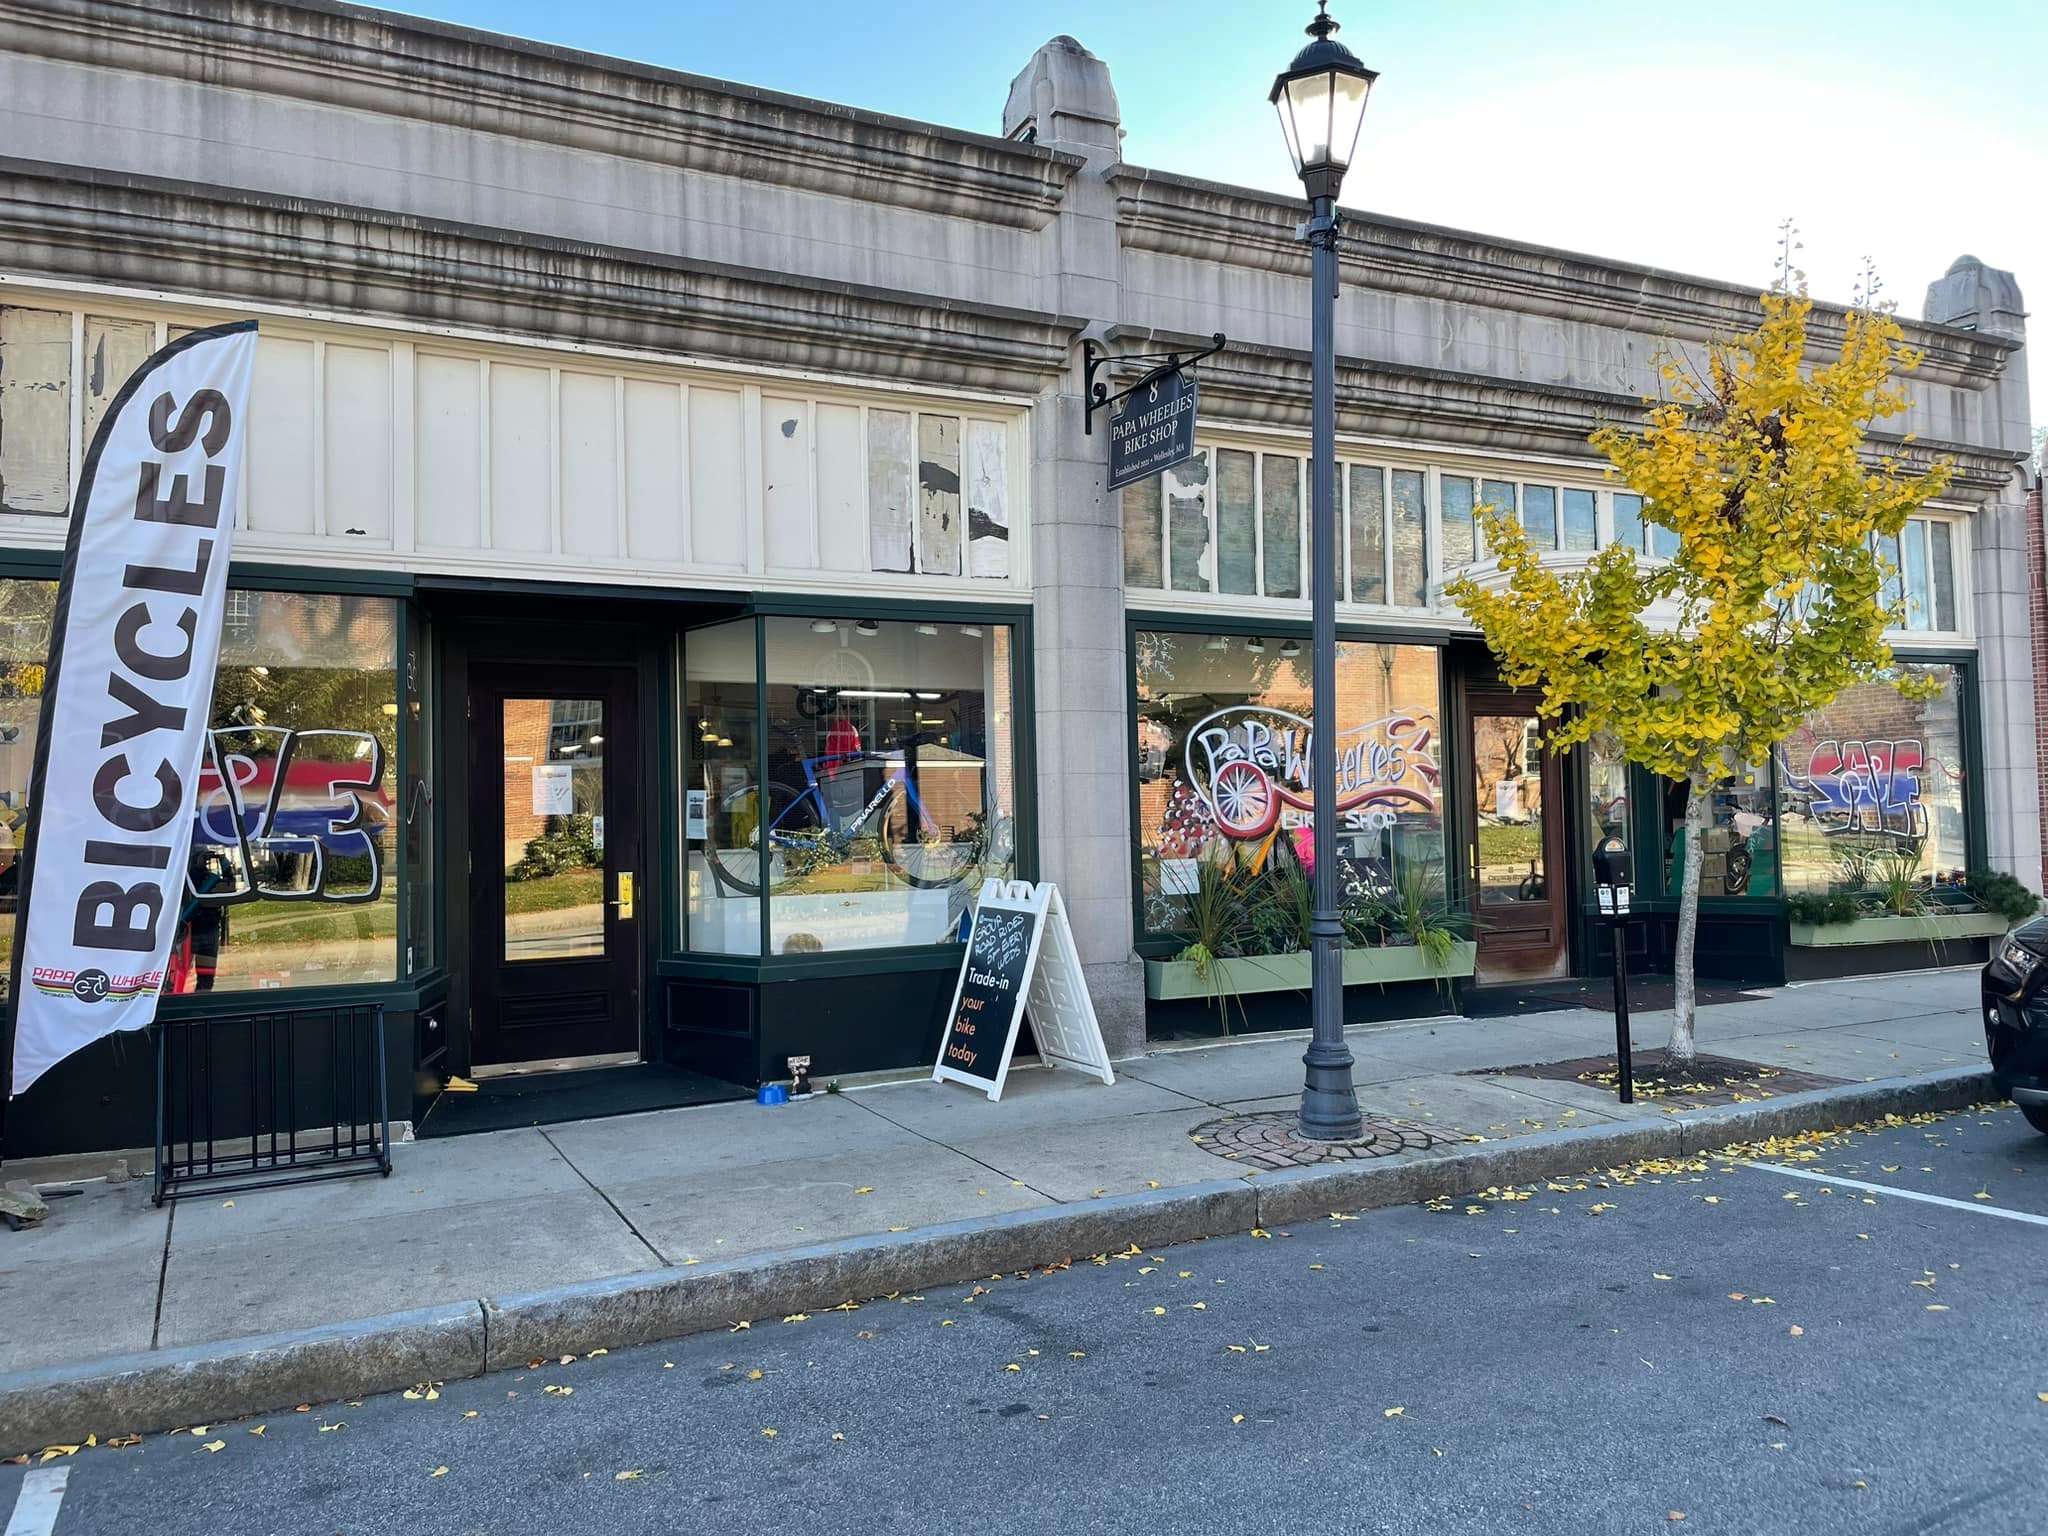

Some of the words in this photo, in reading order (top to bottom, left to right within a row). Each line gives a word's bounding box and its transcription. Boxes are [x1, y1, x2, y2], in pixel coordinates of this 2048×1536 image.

[1149, 380, 1158, 403] 8
[1112, 420, 1136, 440] PAPA
[1139, 393, 1193, 429] WHEELIES
[1124, 433, 1148, 455] BIKE
[1149, 420, 1178, 445] SHOP
[73, 388, 232, 952] BICYCLES
[1808, 739, 1928, 838] SALE
[850, 779, 896, 832] PINARELLO
[1281, 810, 1315, 830] BIK
[1344, 809, 1397, 830] SHOP
[975, 914, 1002, 942] GROUP
[998, 913, 1024, 938] RIDES
[32, 967, 76, 982] PAPA
[969, 967, 1009, 990] Trade-in
[960, 996, 984, 1011] your
[955, 1016, 976, 1035] bike
[948, 1043, 977, 1067] today
